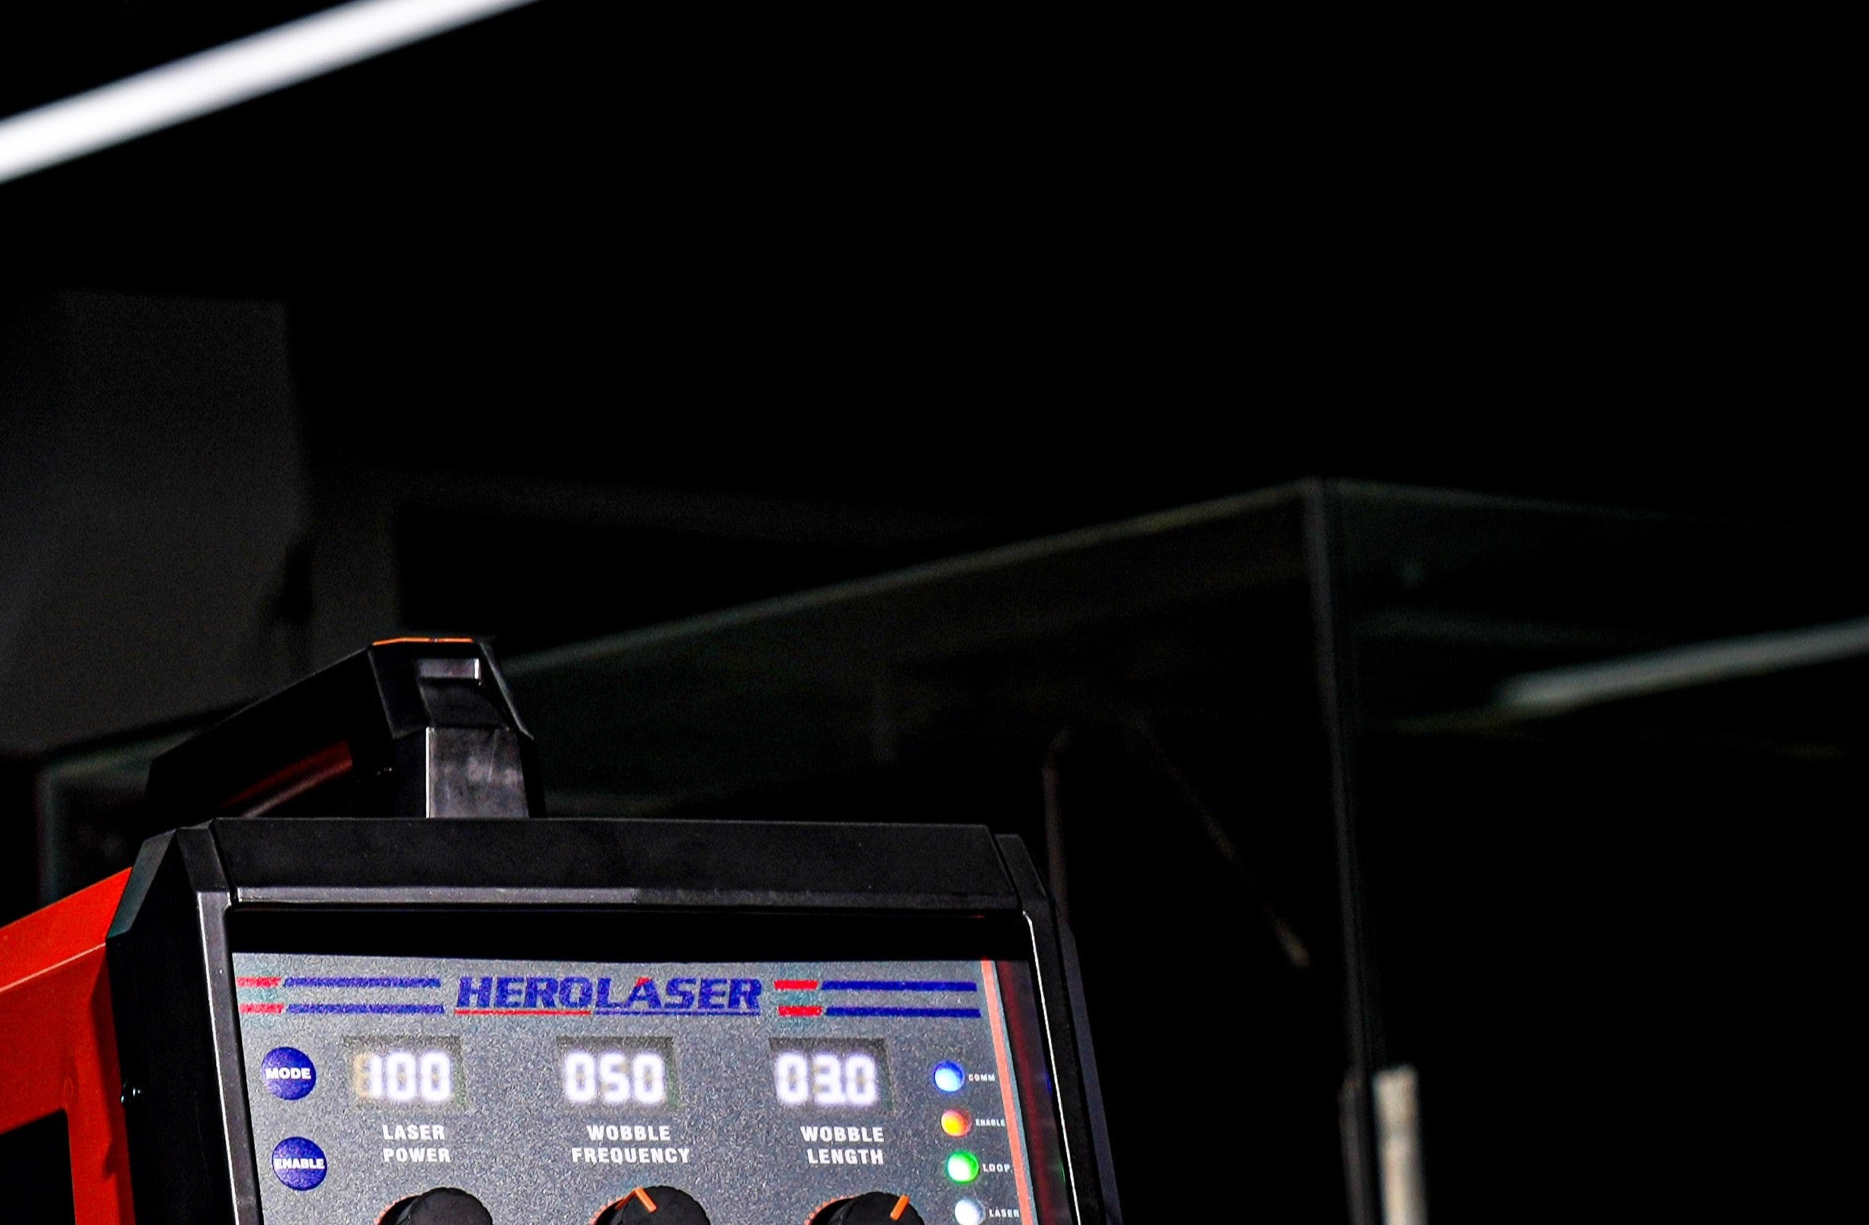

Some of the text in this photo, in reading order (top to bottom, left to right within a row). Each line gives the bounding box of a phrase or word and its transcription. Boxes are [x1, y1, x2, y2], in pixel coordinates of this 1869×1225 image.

[456, 976, 762, 1010] HEROLASER
[265, 1067, 312, 1080] MODE
[367, 1051, 452, 1101] 100
[564, 1052, 665, 1104] 050
[968, 1073, 997, 1082] COMM
[382, 1124, 445, 1141] LASER
[586, 1125, 671, 1141] WOBBLE
[800, 1126, 885, 1142] WOBBLE
[383, 1147, 452, 1163] POWER
[571, 1147, 690, 1165] FREQUENCY
[807, 1148, 884, 1165] LENGTH
[273, 1158, 326, 1169] ENABLE
[989, 1208, 1020, 1218] LASER
